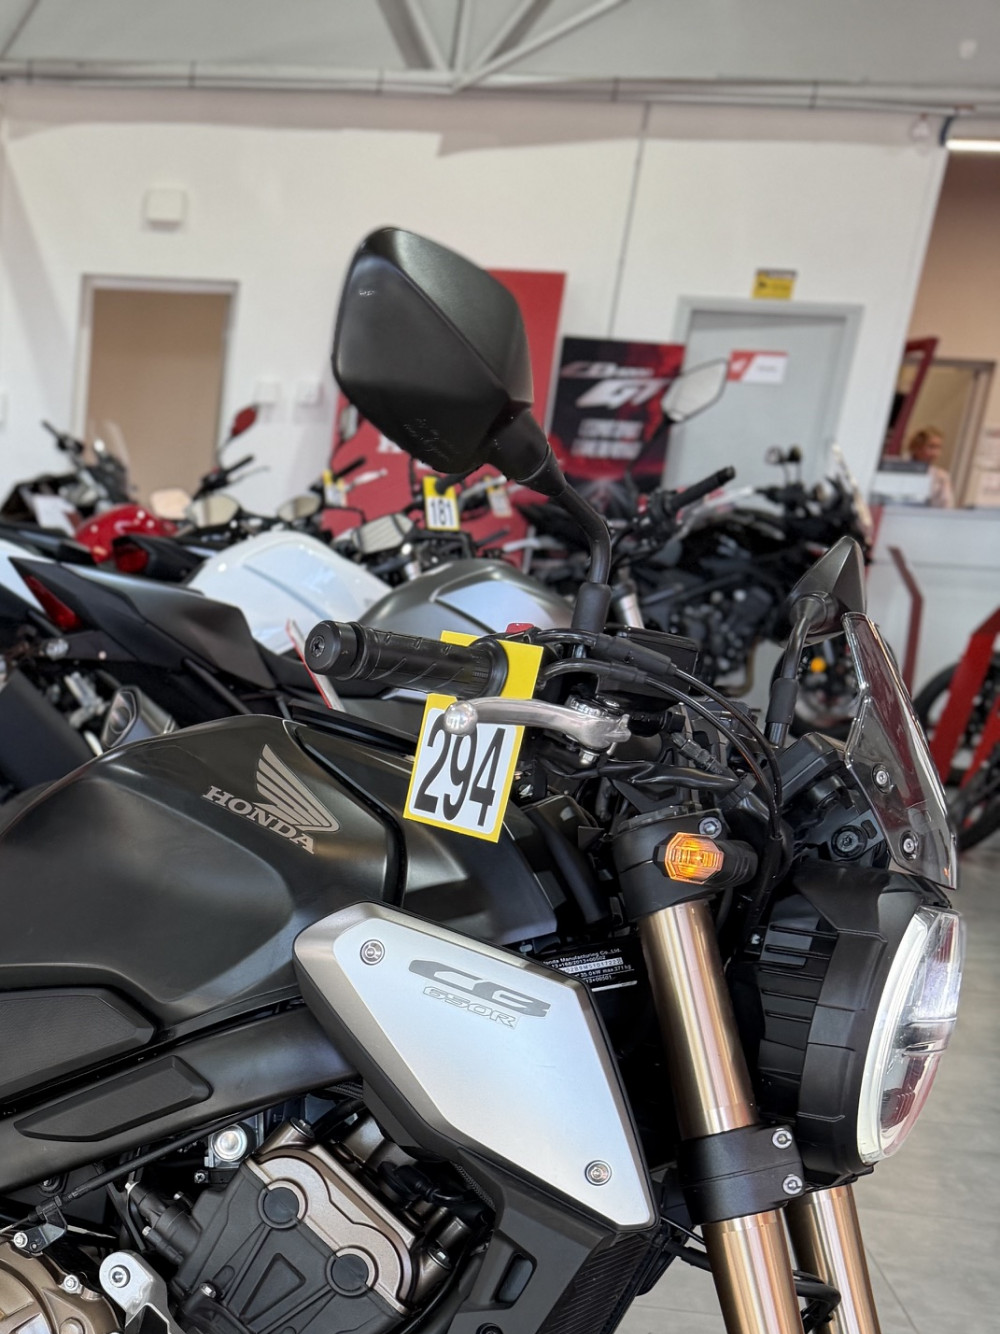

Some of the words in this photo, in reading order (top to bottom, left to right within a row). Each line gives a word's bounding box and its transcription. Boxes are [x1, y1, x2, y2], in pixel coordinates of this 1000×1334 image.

[413, 712, 506, 827] 294
[202, 785, 315, 855] HONDA
[409, 959, 551, 1018] CB
[422, 986, 518, 1029] 650R
